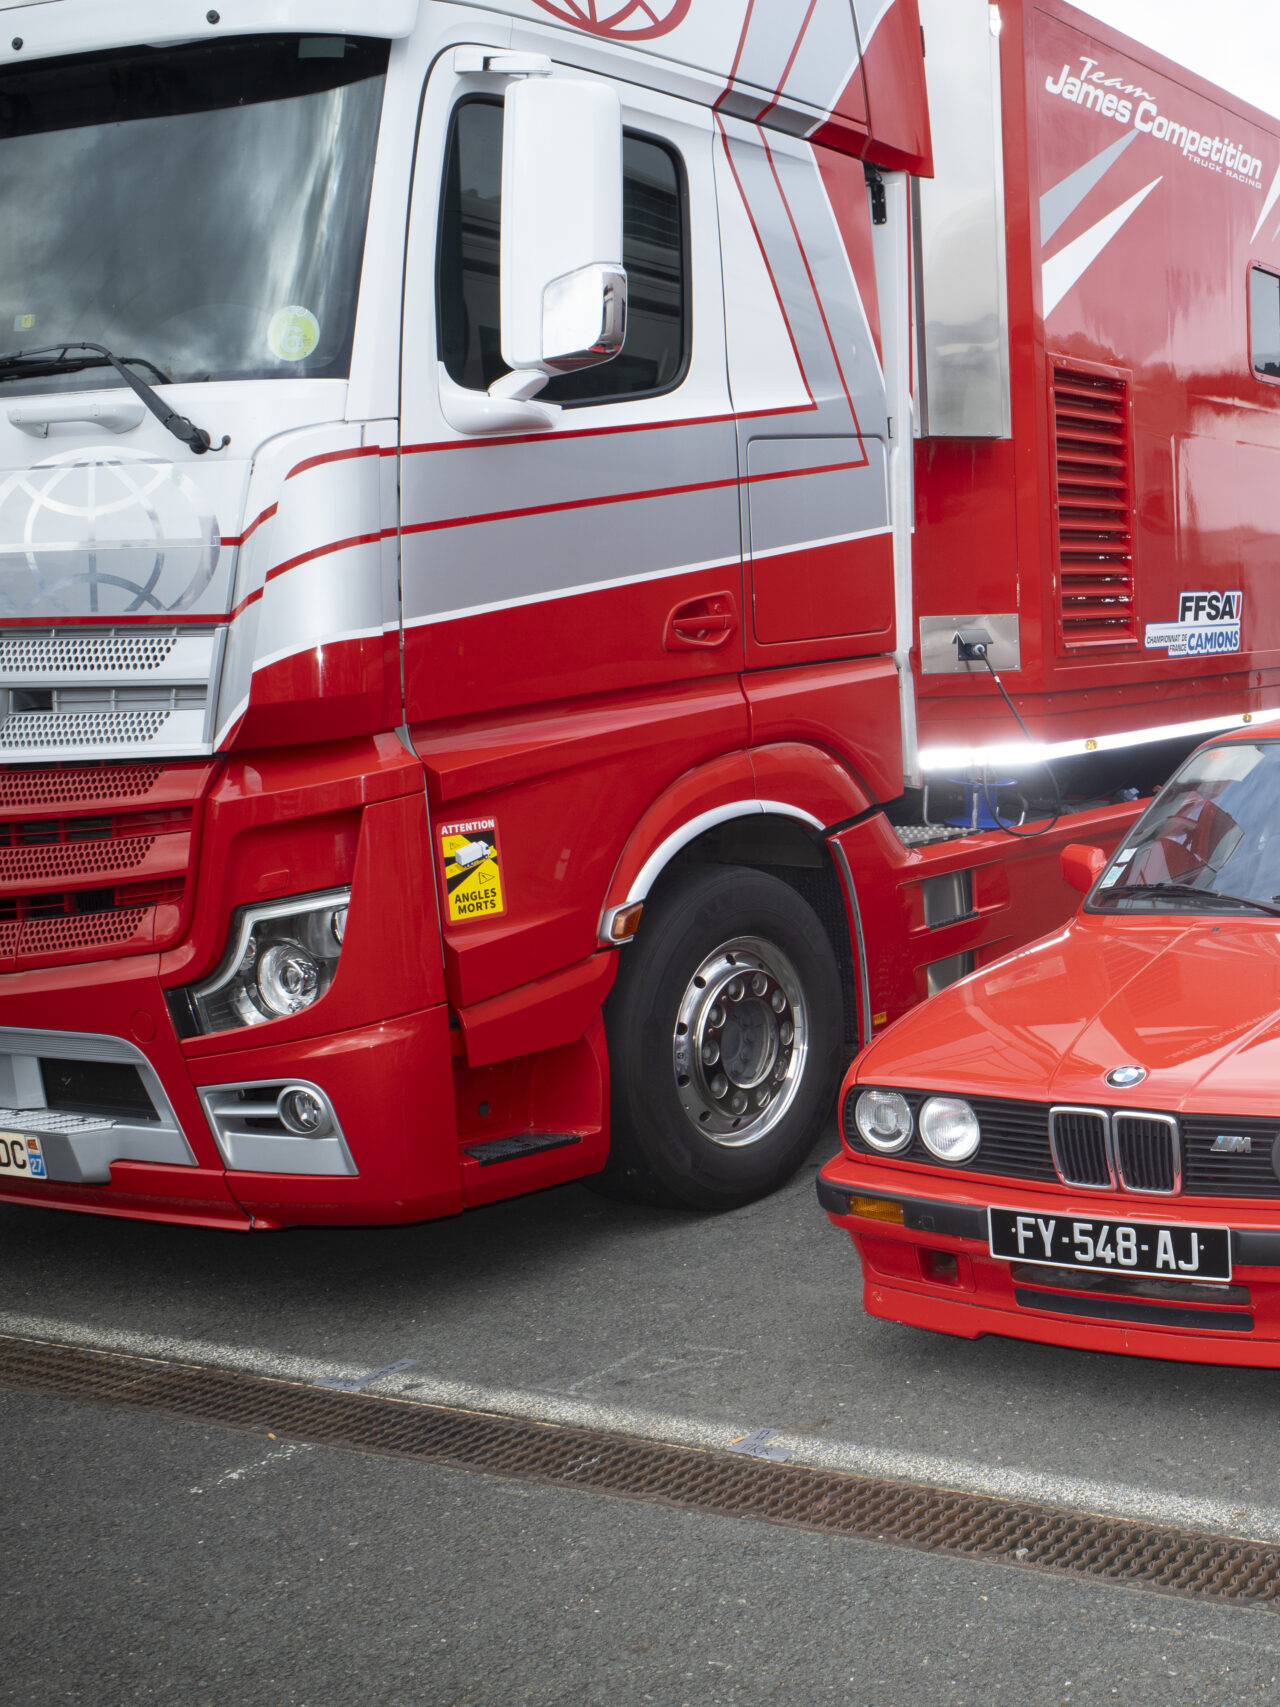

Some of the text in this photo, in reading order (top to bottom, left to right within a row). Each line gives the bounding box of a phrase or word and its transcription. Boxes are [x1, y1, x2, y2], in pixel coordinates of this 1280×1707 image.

[1079, 56, 1156, 100] Team
[1045, 64, 1263, 180] James Competition
[1187, 153, 1263, 190] TRUCK RACING
[1180, 594, 1235, 622] FFSA
[1146, 633, 1188, 644] CHAMPIONNAT DE
[1169, 643, 1187, 653] FRANCE
[1187, 630, 1239, 651] CAMIONS
[441, 819, 495, 835] ATTENTION
[454, 887, 497, 905] ANGLES
[458, 899, 497, 915] MORTS
[31, 1158, 42, 1173] 27
[1016, 1216, 1199, 1272] FY-548-AJ
